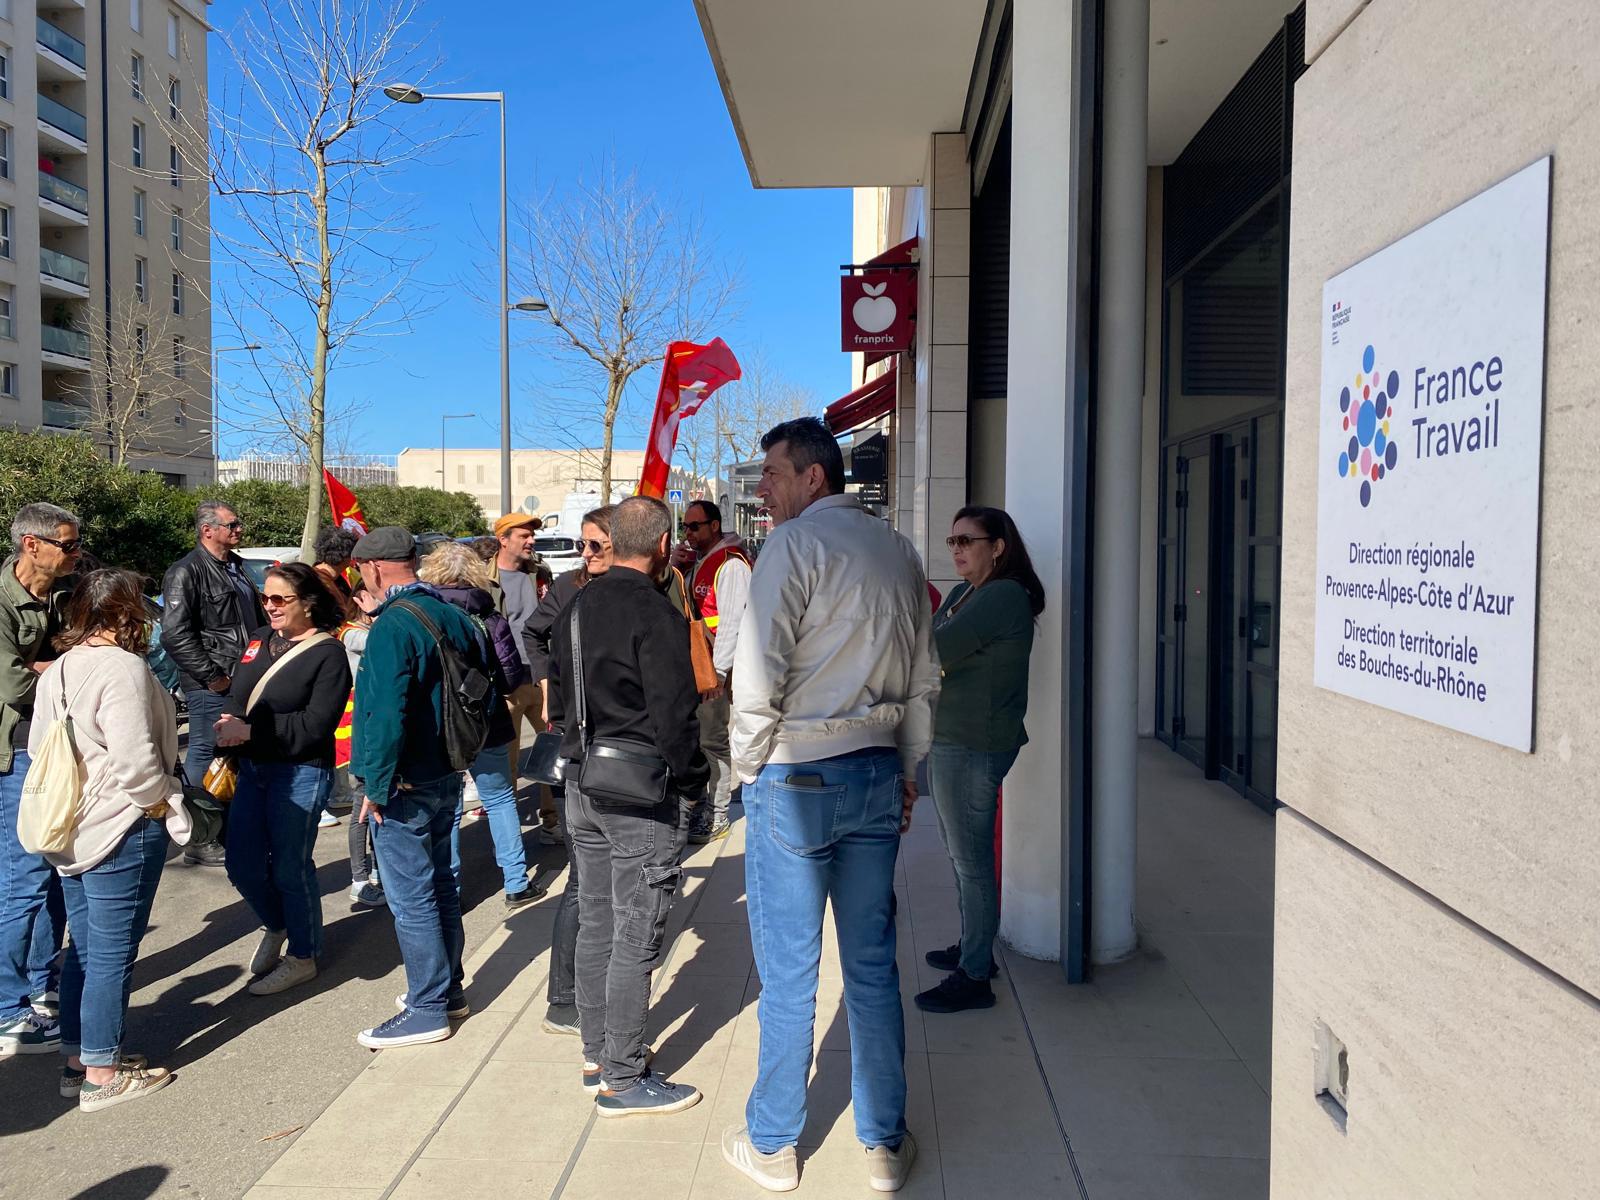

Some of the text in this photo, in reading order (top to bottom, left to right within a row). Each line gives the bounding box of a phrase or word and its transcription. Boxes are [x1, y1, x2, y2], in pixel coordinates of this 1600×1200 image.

[854, 333, 895, 345] franprix
[1413, 355, 1503, 410] France
[1411, 398, 1500, 459] Travail
[1349, 540, 1475, 574] Direction régionale
[1325, 575, 1515, 616] Provence-Alpes-Côte d'Azur
[1344, 618, 1478, 665] Direction territoriale
[1337, 645, 1487, 703] des Bouches-du-Rhône
